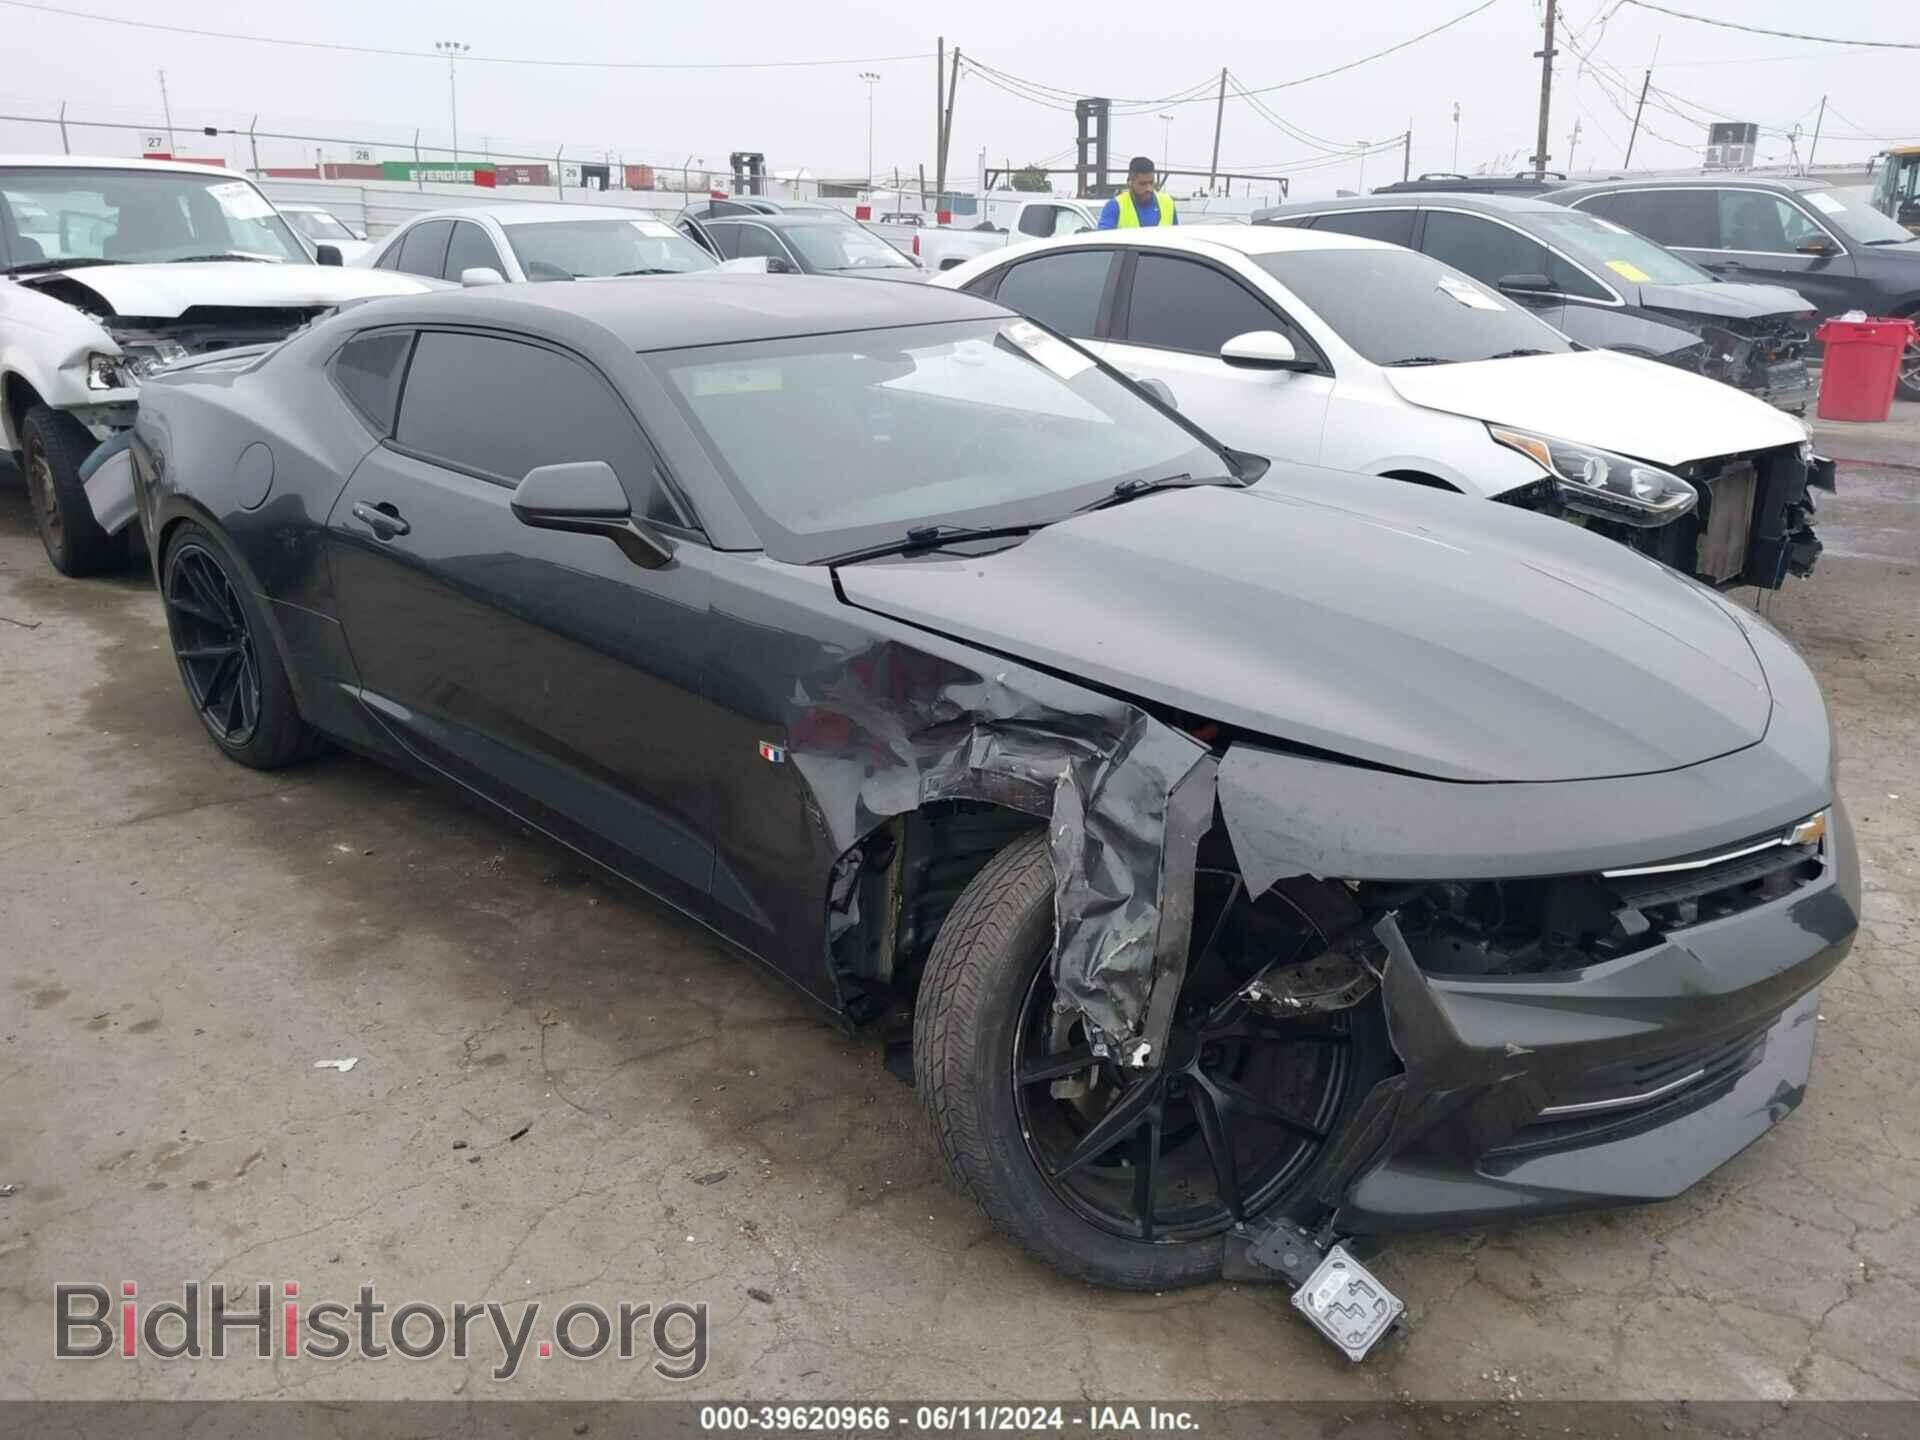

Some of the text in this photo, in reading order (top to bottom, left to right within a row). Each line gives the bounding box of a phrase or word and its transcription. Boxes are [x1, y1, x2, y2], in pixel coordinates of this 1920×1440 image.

[147, 137, 162, 148] 27
[355, 150, 370, 161] 28
[566, 168, 577, 178] 29
